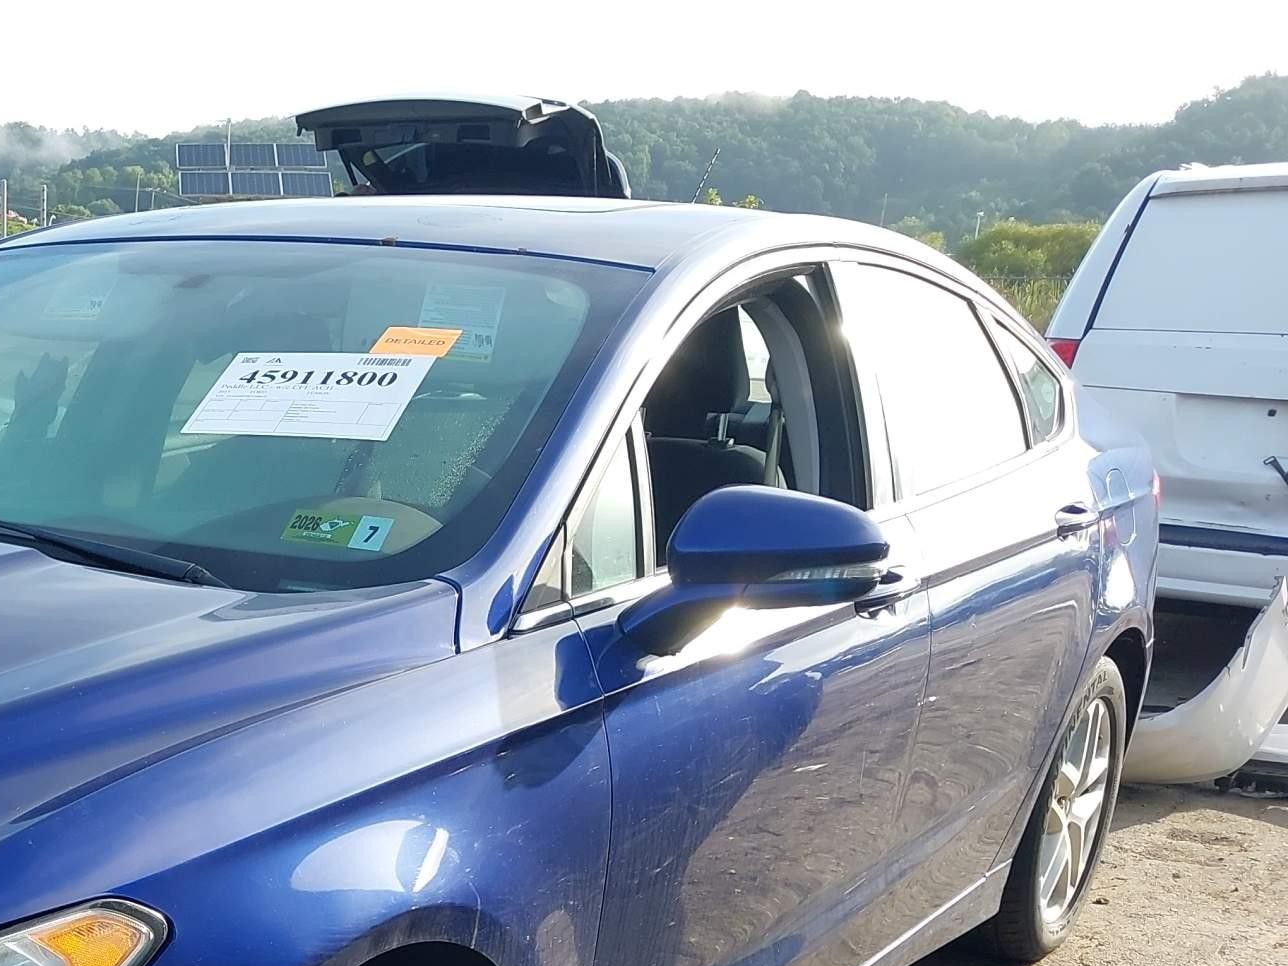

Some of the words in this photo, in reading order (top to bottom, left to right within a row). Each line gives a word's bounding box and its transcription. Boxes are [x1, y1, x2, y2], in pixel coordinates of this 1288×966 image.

[384, 336, 446, 347] DETAILED
[238, 363, 399, 388] 45911800
[363, 526, 380, 544] 7
